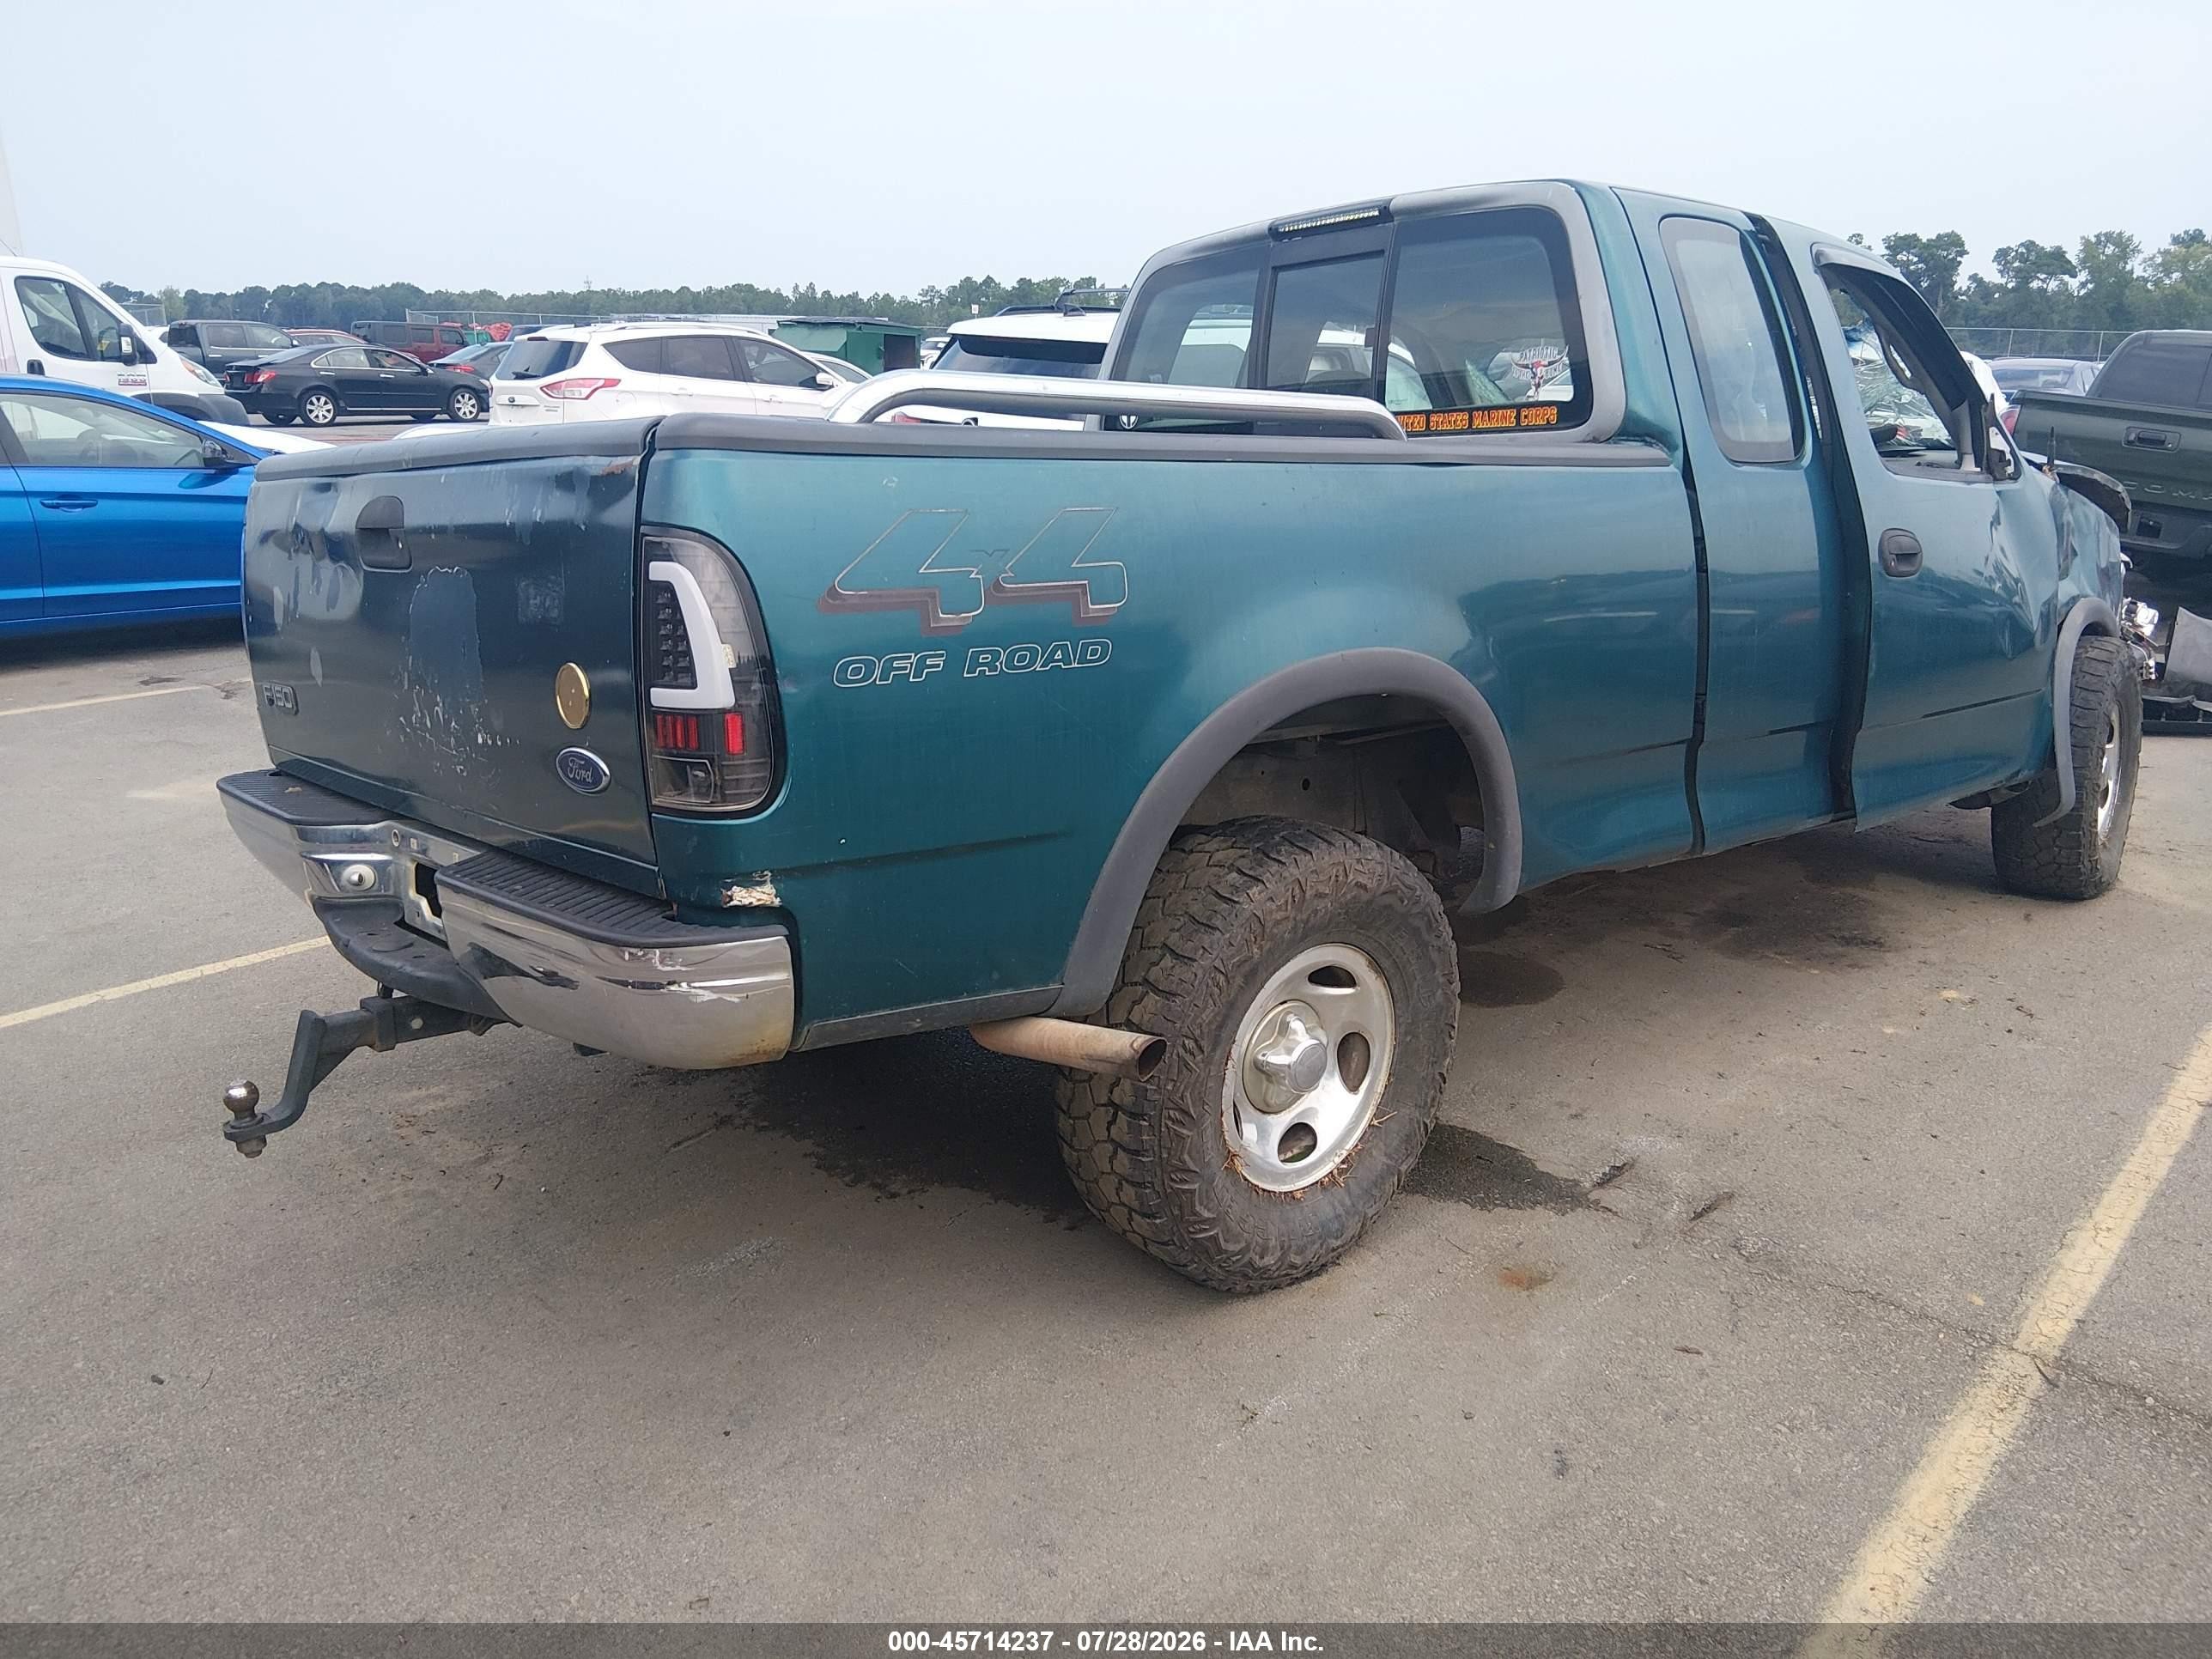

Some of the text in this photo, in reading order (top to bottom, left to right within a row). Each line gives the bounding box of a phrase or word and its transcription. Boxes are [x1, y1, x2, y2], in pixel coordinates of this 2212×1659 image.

[1429, 412, 1468, 430] STATES
[1472, 409, 1516, 428] MARINE
[1520, 406, 1558, 426] CORPS
[833, 638, 1113, 688] OFF ROAD
[568, 757, 594, 783] Ford
